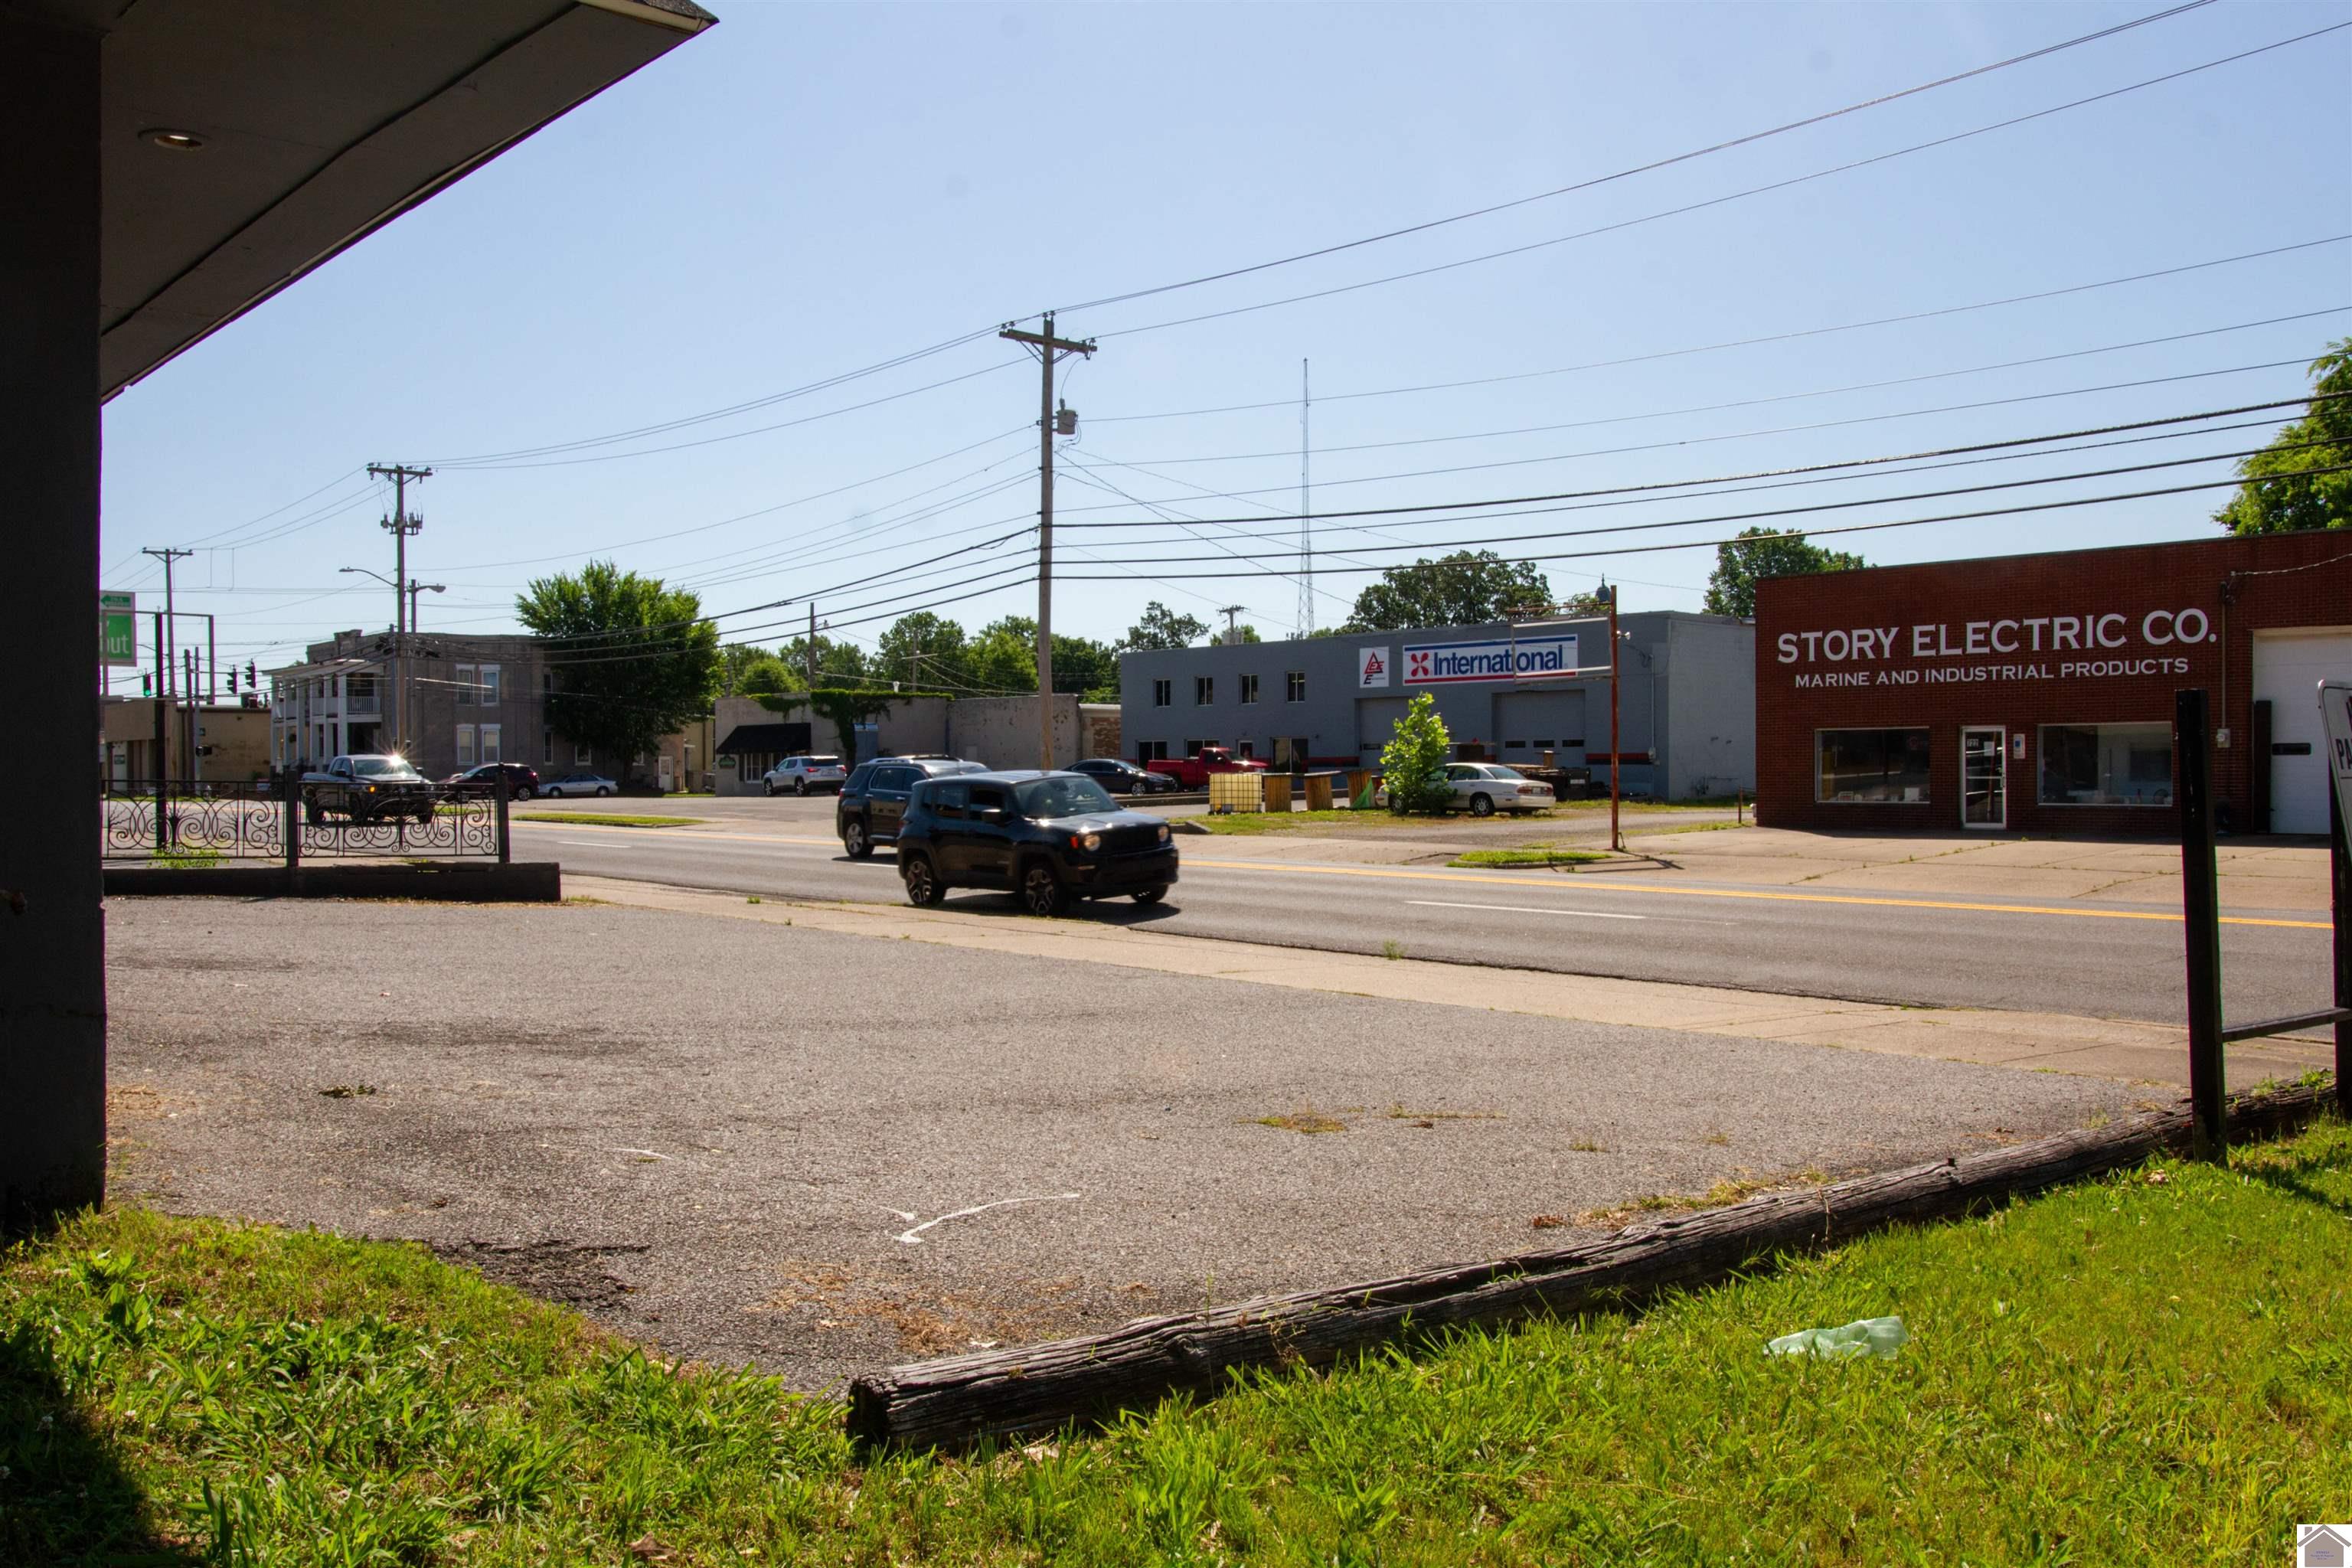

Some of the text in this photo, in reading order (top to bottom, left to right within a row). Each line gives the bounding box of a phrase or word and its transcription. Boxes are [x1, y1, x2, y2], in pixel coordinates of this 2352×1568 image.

[1777, 608, 2217, 664] STORY ELECTRIC CO.
[1434, 645, 1562, 676] Internatonal
[1795, 658, 2188, 688] MARINE AND INDUSTRIAL PRODUCTS
